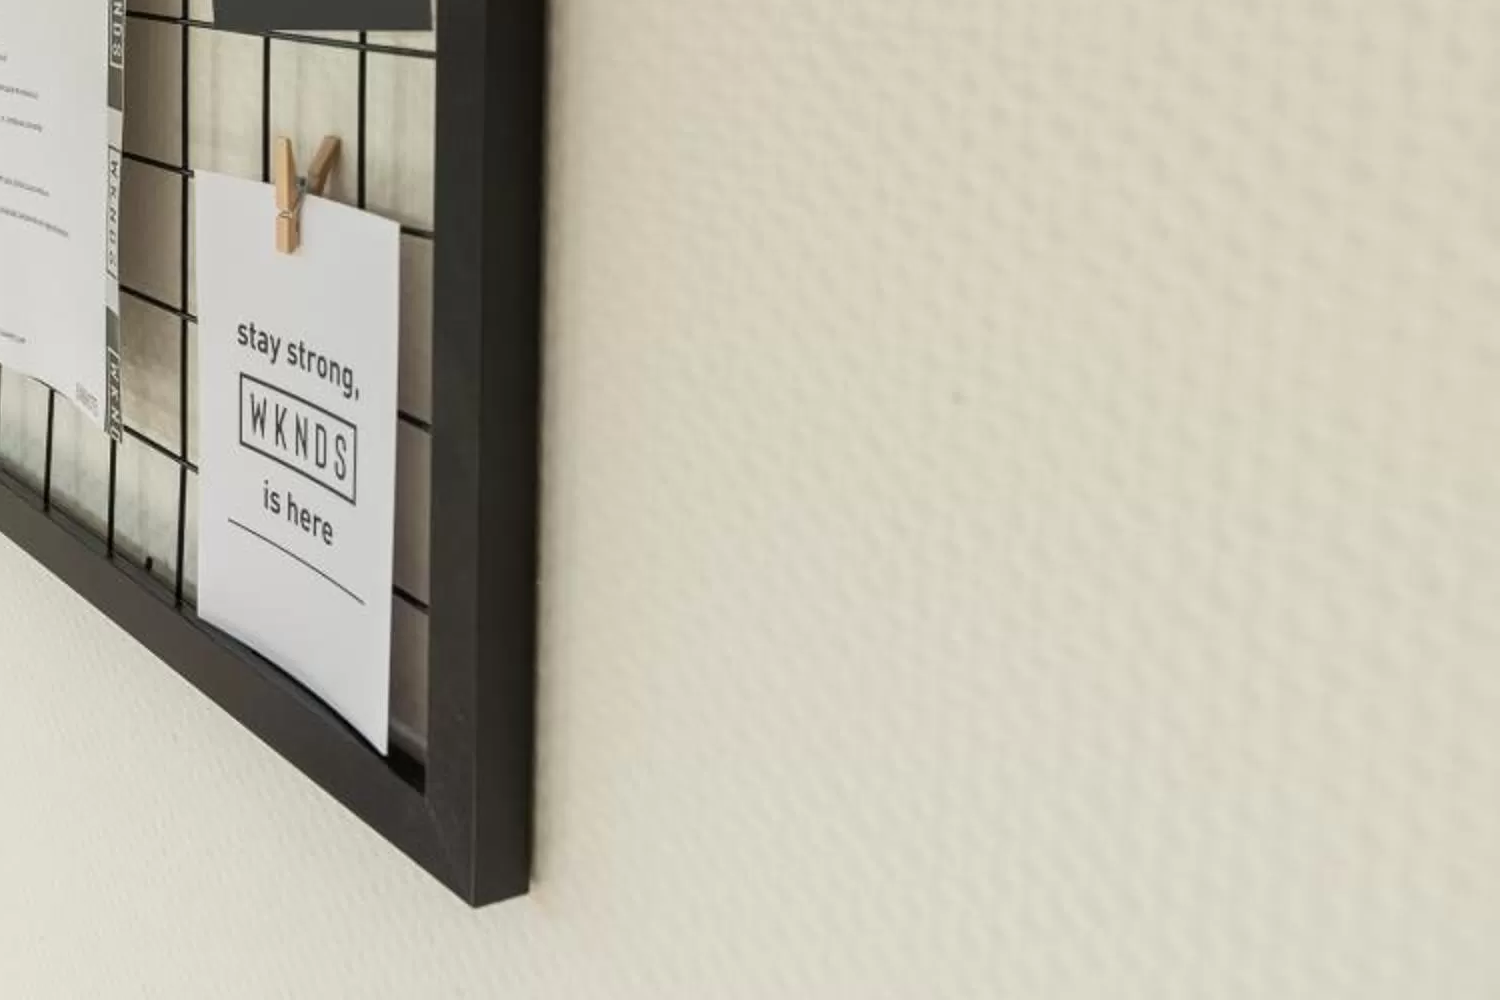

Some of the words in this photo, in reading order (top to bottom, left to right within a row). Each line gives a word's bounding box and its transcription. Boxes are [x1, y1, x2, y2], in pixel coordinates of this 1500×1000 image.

[237, 322, 281, 364] stay
[287, 340, 359, 401] strong,
[250, 392, 347, 481] WKNDS
[263, 480, 281, 514] is
[287, 491, 333, 546] here
